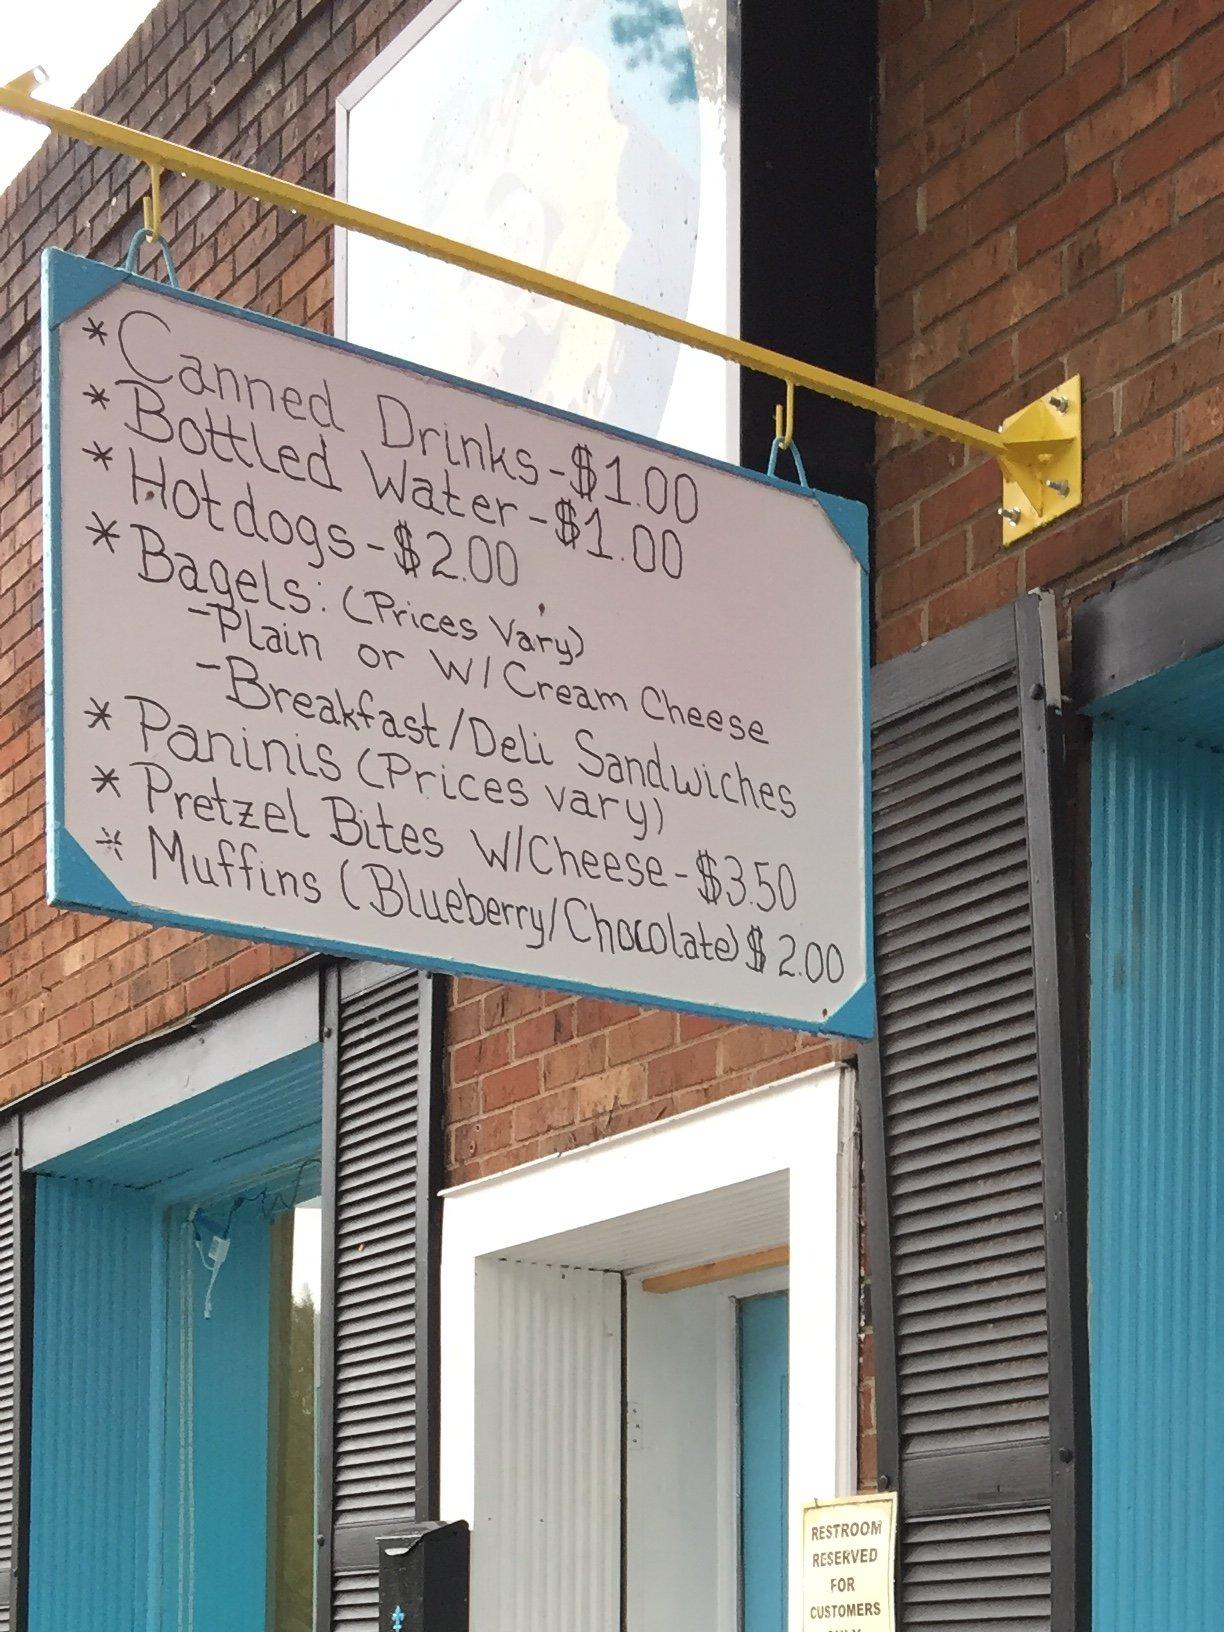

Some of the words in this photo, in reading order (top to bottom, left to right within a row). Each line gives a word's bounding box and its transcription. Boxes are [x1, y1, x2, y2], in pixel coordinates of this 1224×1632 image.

[117, 310, 345, 432] Canned
[115, 380, 342, 492] Bottled
[130, 524, 327, 613] Bagels:
[342, 585, 478, 640] (Prices
[489, 615, 584, 665] Vary)
[357, 644, 404, 670] or
[641, 686, 769, 744] Cheese
[124, 695, 341, 782] Paninis
[358, 748, 529, 806] (Prices
[545, 784, 664, 840] vary)
[129, 761, 310, 838] Pretzel
[321, 796, 444, 857] Bites
[576, 729, 797, 818] Sandwiches
[149, 825, 322, 903] Muffins
[811, 1520, 882, 1541] RESTROOM
[812, 1548, 878, 1567] RESERVED
[810, 1602, 881, 1619] CUSTOMERS
[830, 1577, 855, 1592] FOR
